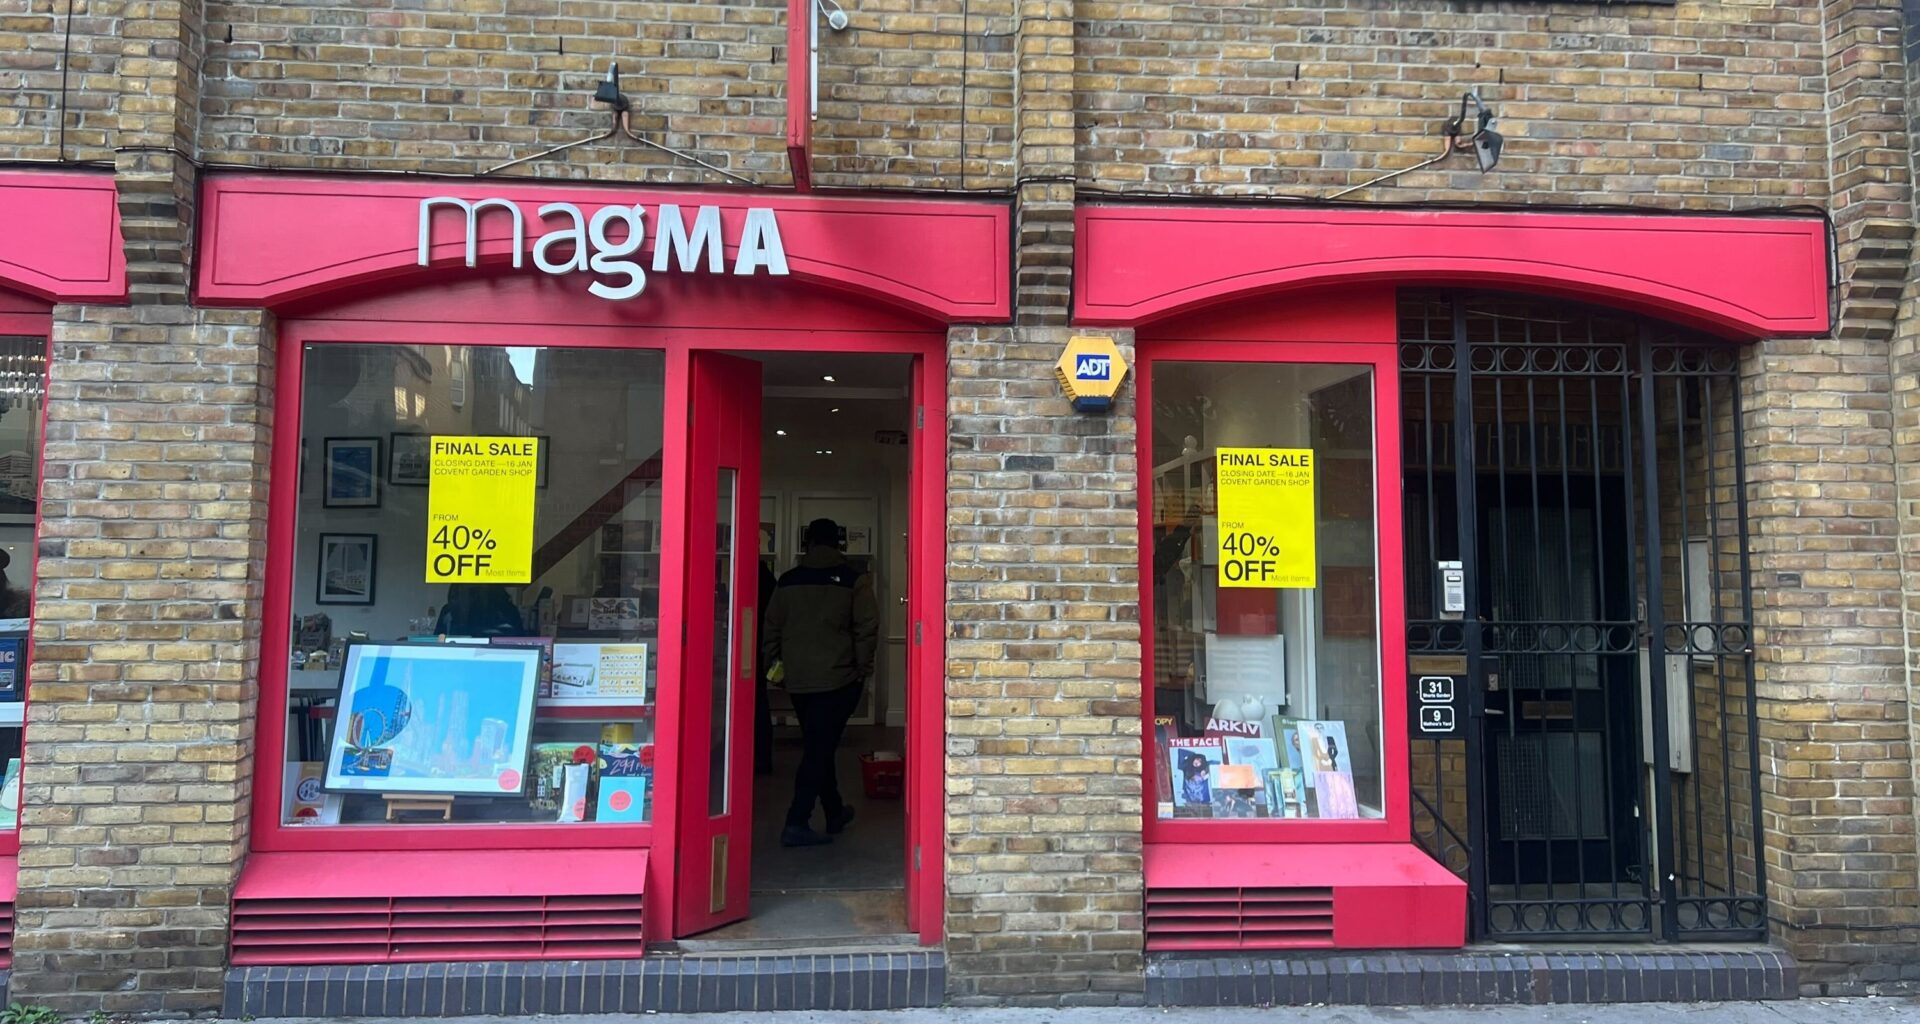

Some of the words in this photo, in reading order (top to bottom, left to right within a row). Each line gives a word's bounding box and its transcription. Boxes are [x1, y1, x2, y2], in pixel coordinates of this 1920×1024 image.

[1076, 359, 1110, 376] ADT
[435, 442, 484, 455] FINAL
[489, 443, 533, 456] SALE
[435, 459, 472, 467] CLOSING
[1220, 454, 1265, 466] FINAL
[1269, 454, 1309, 467] SALE
[434, 468, 469, 476] COVENT
[472, 468, 507, 476] GARDEN
[433, 525, 496, 550] 40%
[1222, 533, 1280, 556] 40%
[434, 554, 492, 577] OFF
[1224, 560, 1276, 581] OFF
[1429, 682, 1442, 693] 31
[1433, 710, 1441, 721] 9
[1206, 718, 1259, 734] ARKIV
[1170, 739, 1190, 747] THE
[1193, 738, 1220, 746] FACE
